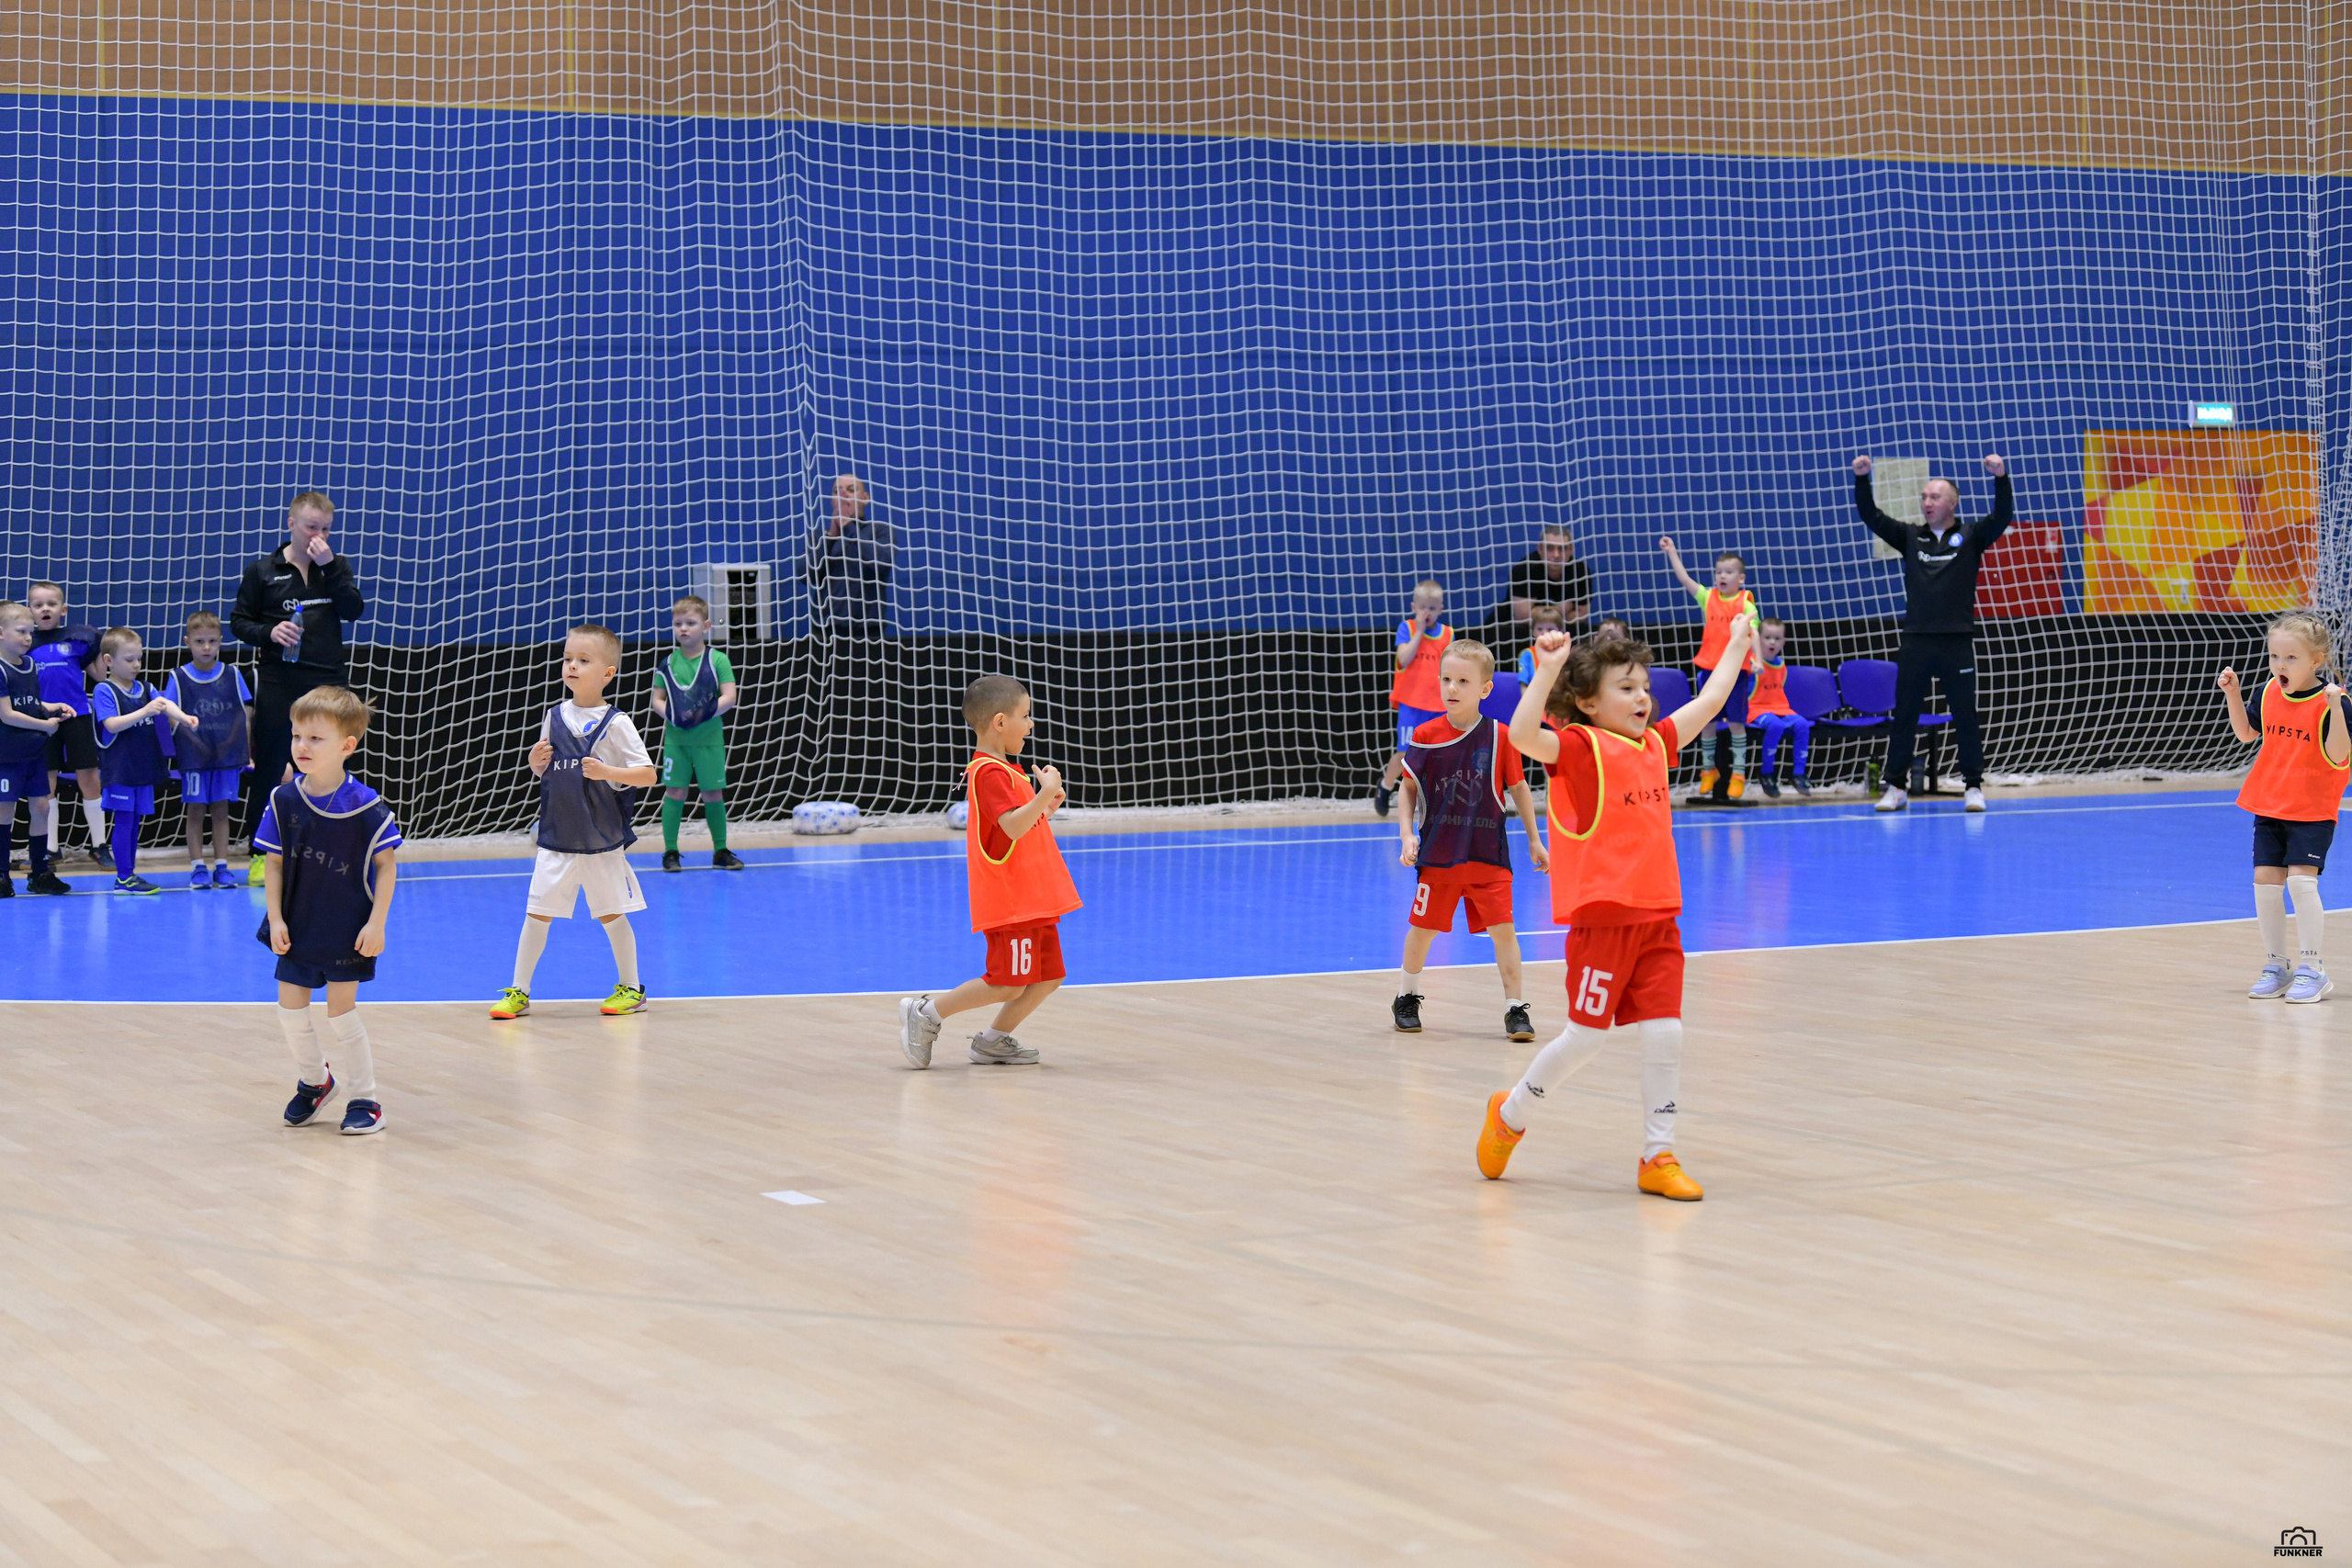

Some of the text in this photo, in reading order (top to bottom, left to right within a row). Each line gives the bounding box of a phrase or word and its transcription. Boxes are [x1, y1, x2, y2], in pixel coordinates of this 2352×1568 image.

[553, 759, 580, 771] KIP
[187, 772, 200, 796] 10
[1413, 882, 1430, 916] 9
[1010, 938, 1032, 976] 16
[1575, 965, 1613, 1017] 15
